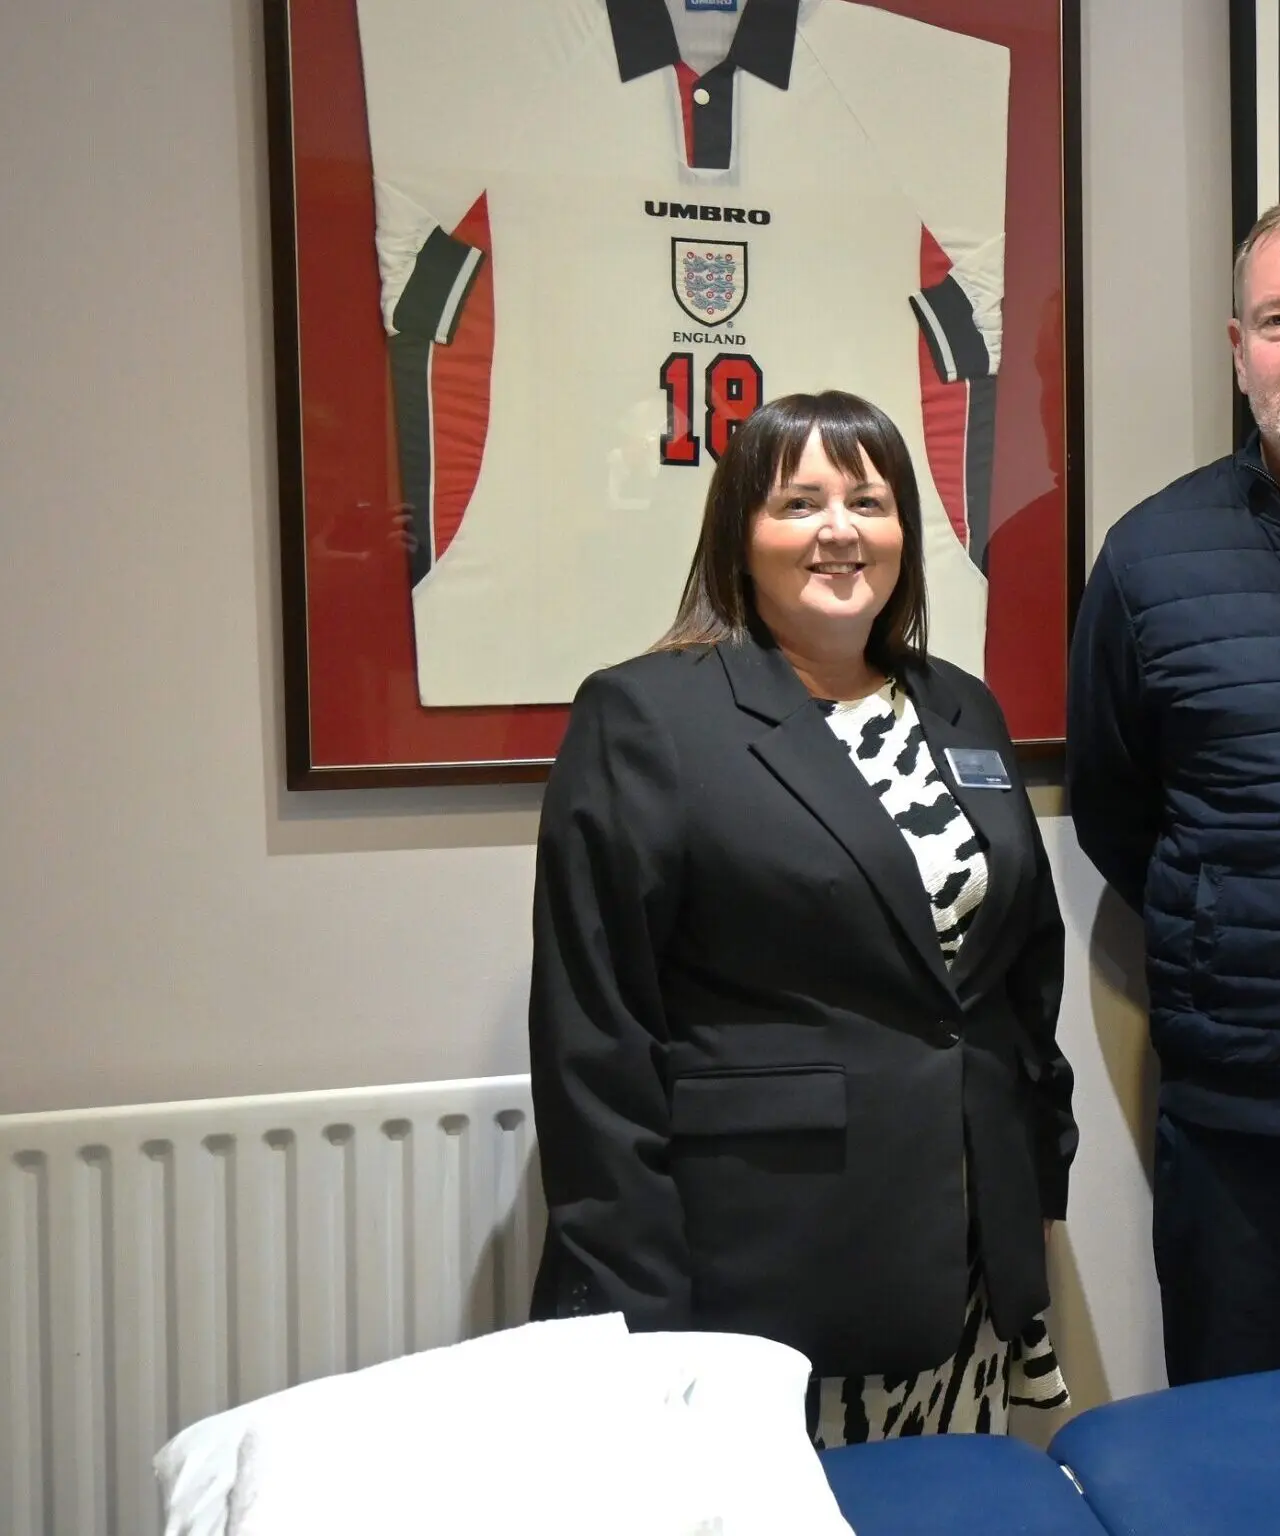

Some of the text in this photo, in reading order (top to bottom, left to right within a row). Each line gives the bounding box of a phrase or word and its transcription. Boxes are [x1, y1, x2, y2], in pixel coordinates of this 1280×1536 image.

[645, 200, 771, 225] UMBRO
[673, 331, 746, 346] ENGLAND
[660, 352, 763, 467] 18
